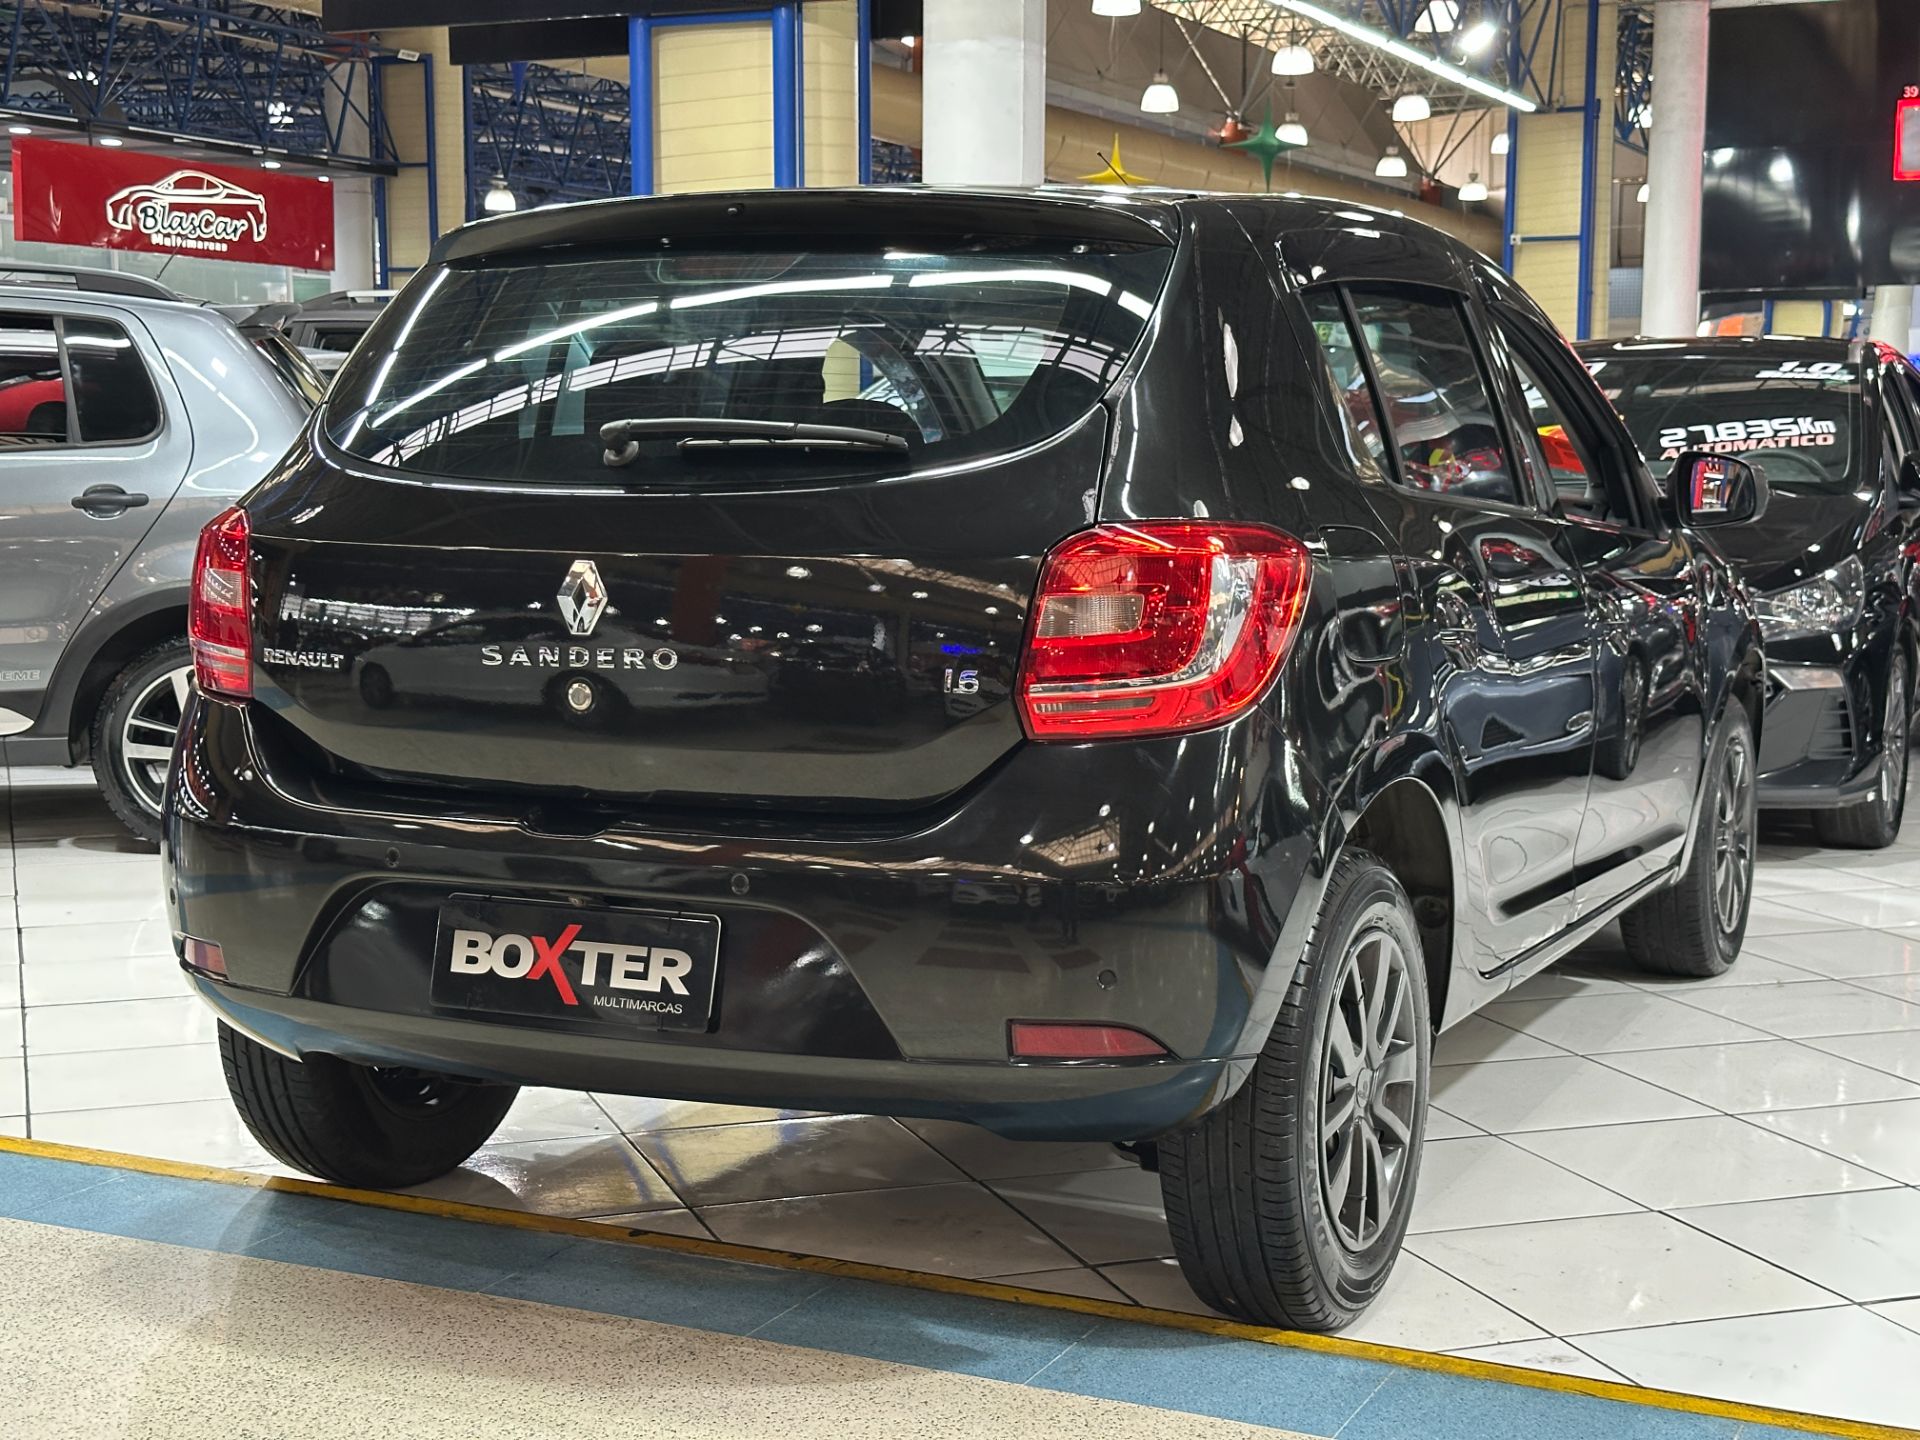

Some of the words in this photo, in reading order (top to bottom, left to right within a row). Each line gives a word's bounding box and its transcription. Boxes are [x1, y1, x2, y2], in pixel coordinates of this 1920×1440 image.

[137, 200, 248, 241] BlasCar
[263, 647, 344, 668] RENAULT
[481, 645, 678, 670] SANDERO
[0, 669, 41, 681] EME
[450, 924, 693, 1006] BOXTER
[593, 995, 683, 1014] MULTIMARCAS
